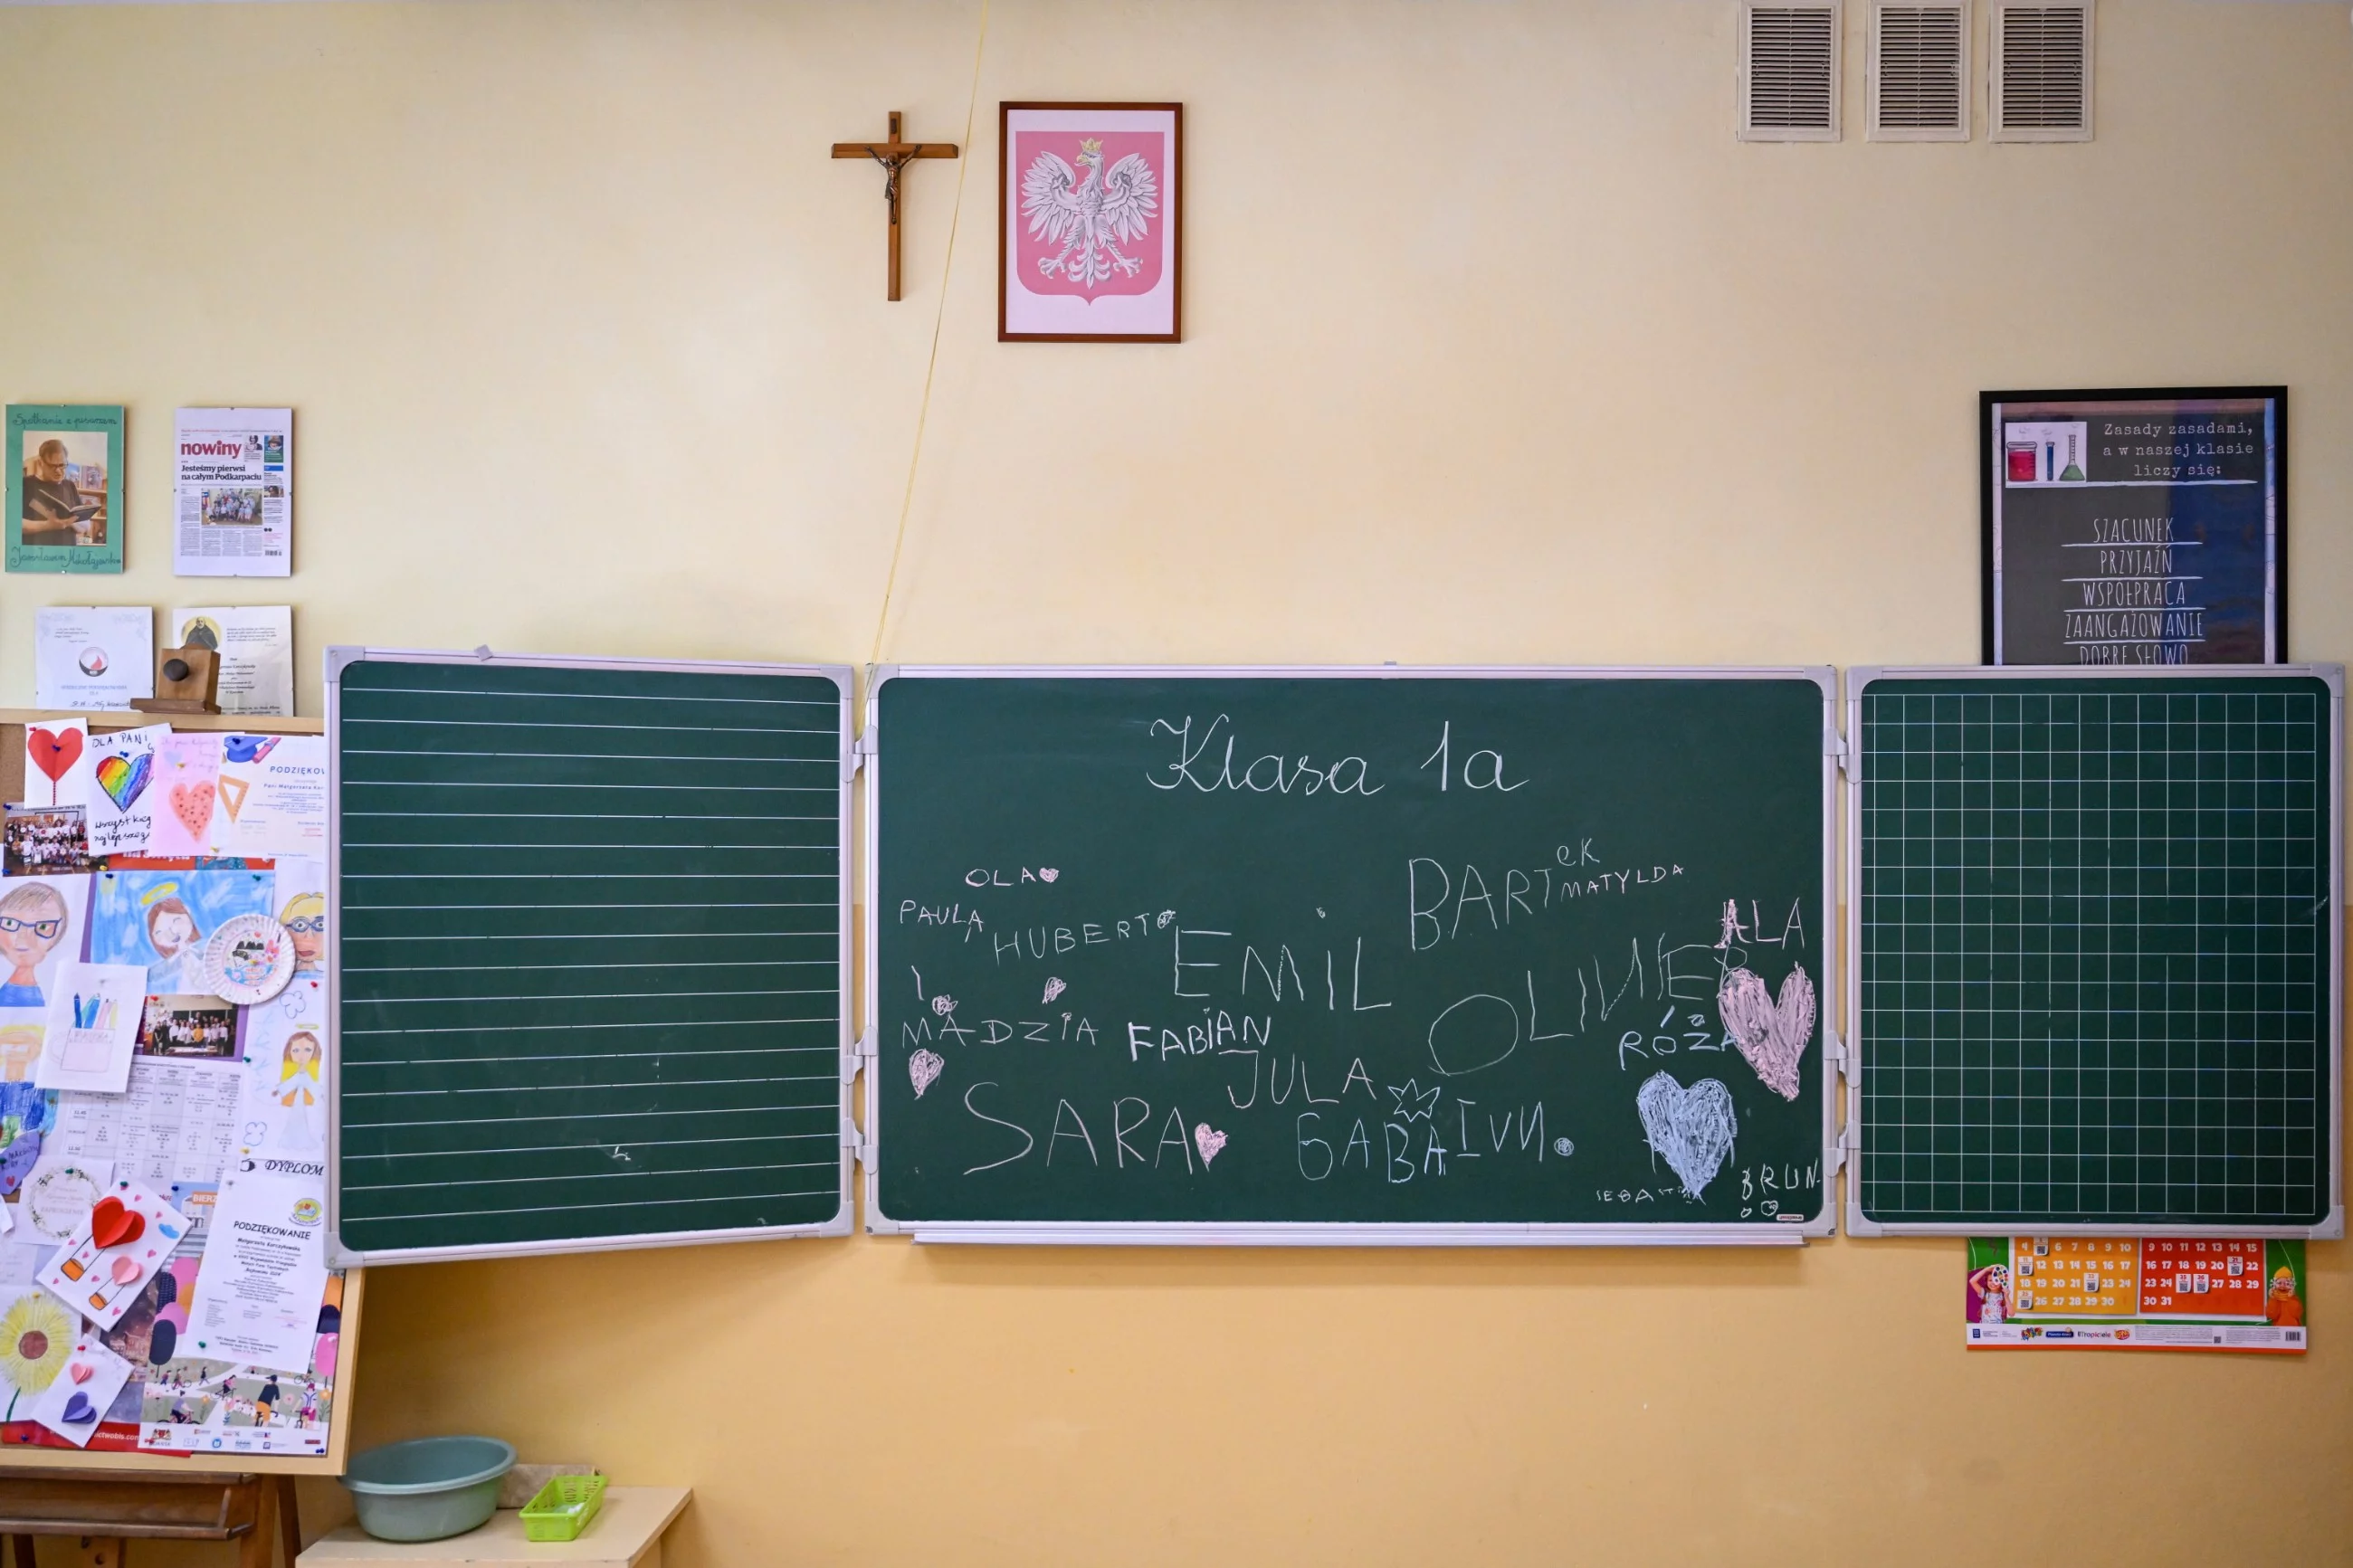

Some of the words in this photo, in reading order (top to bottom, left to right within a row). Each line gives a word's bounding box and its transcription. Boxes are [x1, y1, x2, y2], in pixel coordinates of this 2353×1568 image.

[2104, 423, 2161, 438] Zasady
[2168, 422, 2253, 436] zasadami,
[181, 440, 242, 459] nowiny
[2103, 447, 2111, 456] a
[2119, 447, 2129, 456] w
[2135, 443, 2190, 458] naszej
[2196, 442, 2253, 454] klasie
[181, 465, 216, 473] Jesteśmy
[217, 465, 245, 473] pierwsi
[192, 473, 214, 481] całym
[215, 473, 262, 481] Podkarpaciu
[2134, 464, 2181, 479] liczy
[2187, 463, 2221, 477] się:
[2093, 518, 2174, 543] SZACUNEK
[2101, 545, 2172, 576] PRZYJAŹŃ
[2065, 610, 2204, 639] ZAANGAŻOWANIE
[92, 736, 113, 748] DLA
[1147, 713, 1386, 795] Klasa
[1421, 720, 1529, 792] 1a
[966, 866, 1037, 888] OLA
[1561, 864, 1685, 903] MATYLDA
[900, 899, 986, 944] PAULA
[1713, 896, 1805, 951] ALA
[995, 912, 1150, 967] HUBERT
[1219, 1050, 1379, 1109] JULA
[963, 1082, 1194, 1176] SARA
[264, 1159, 325, 1176] DYPLOM
[233, 1220, 311, 1240] PODZIĘKOWANIE
